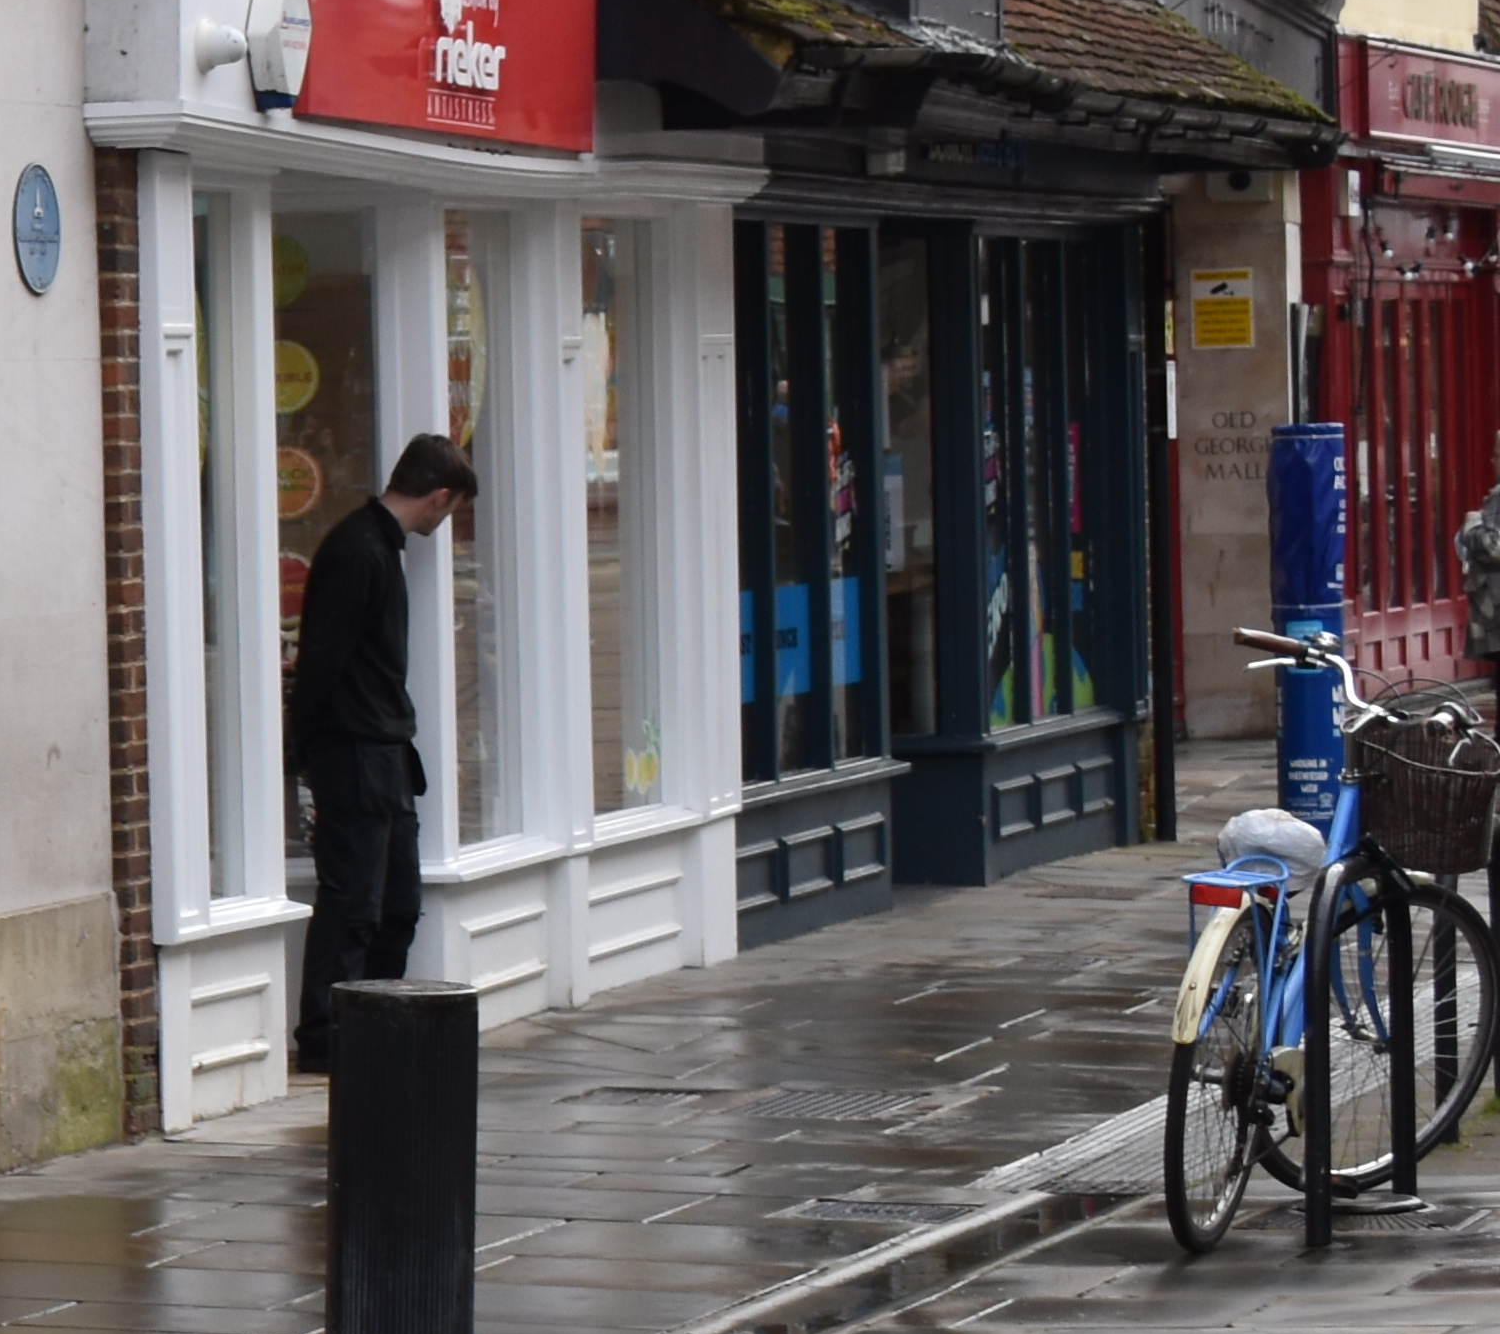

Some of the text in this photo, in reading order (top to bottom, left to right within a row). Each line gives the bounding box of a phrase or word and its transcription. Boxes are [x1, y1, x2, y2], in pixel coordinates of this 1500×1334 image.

[435, 21, 505, 90] rieker
[426, 92, 495, 125] ANTISTRESS
[1211, 412, 1256, 429] OLD
[1204, 462, 1266, 480] MALL
